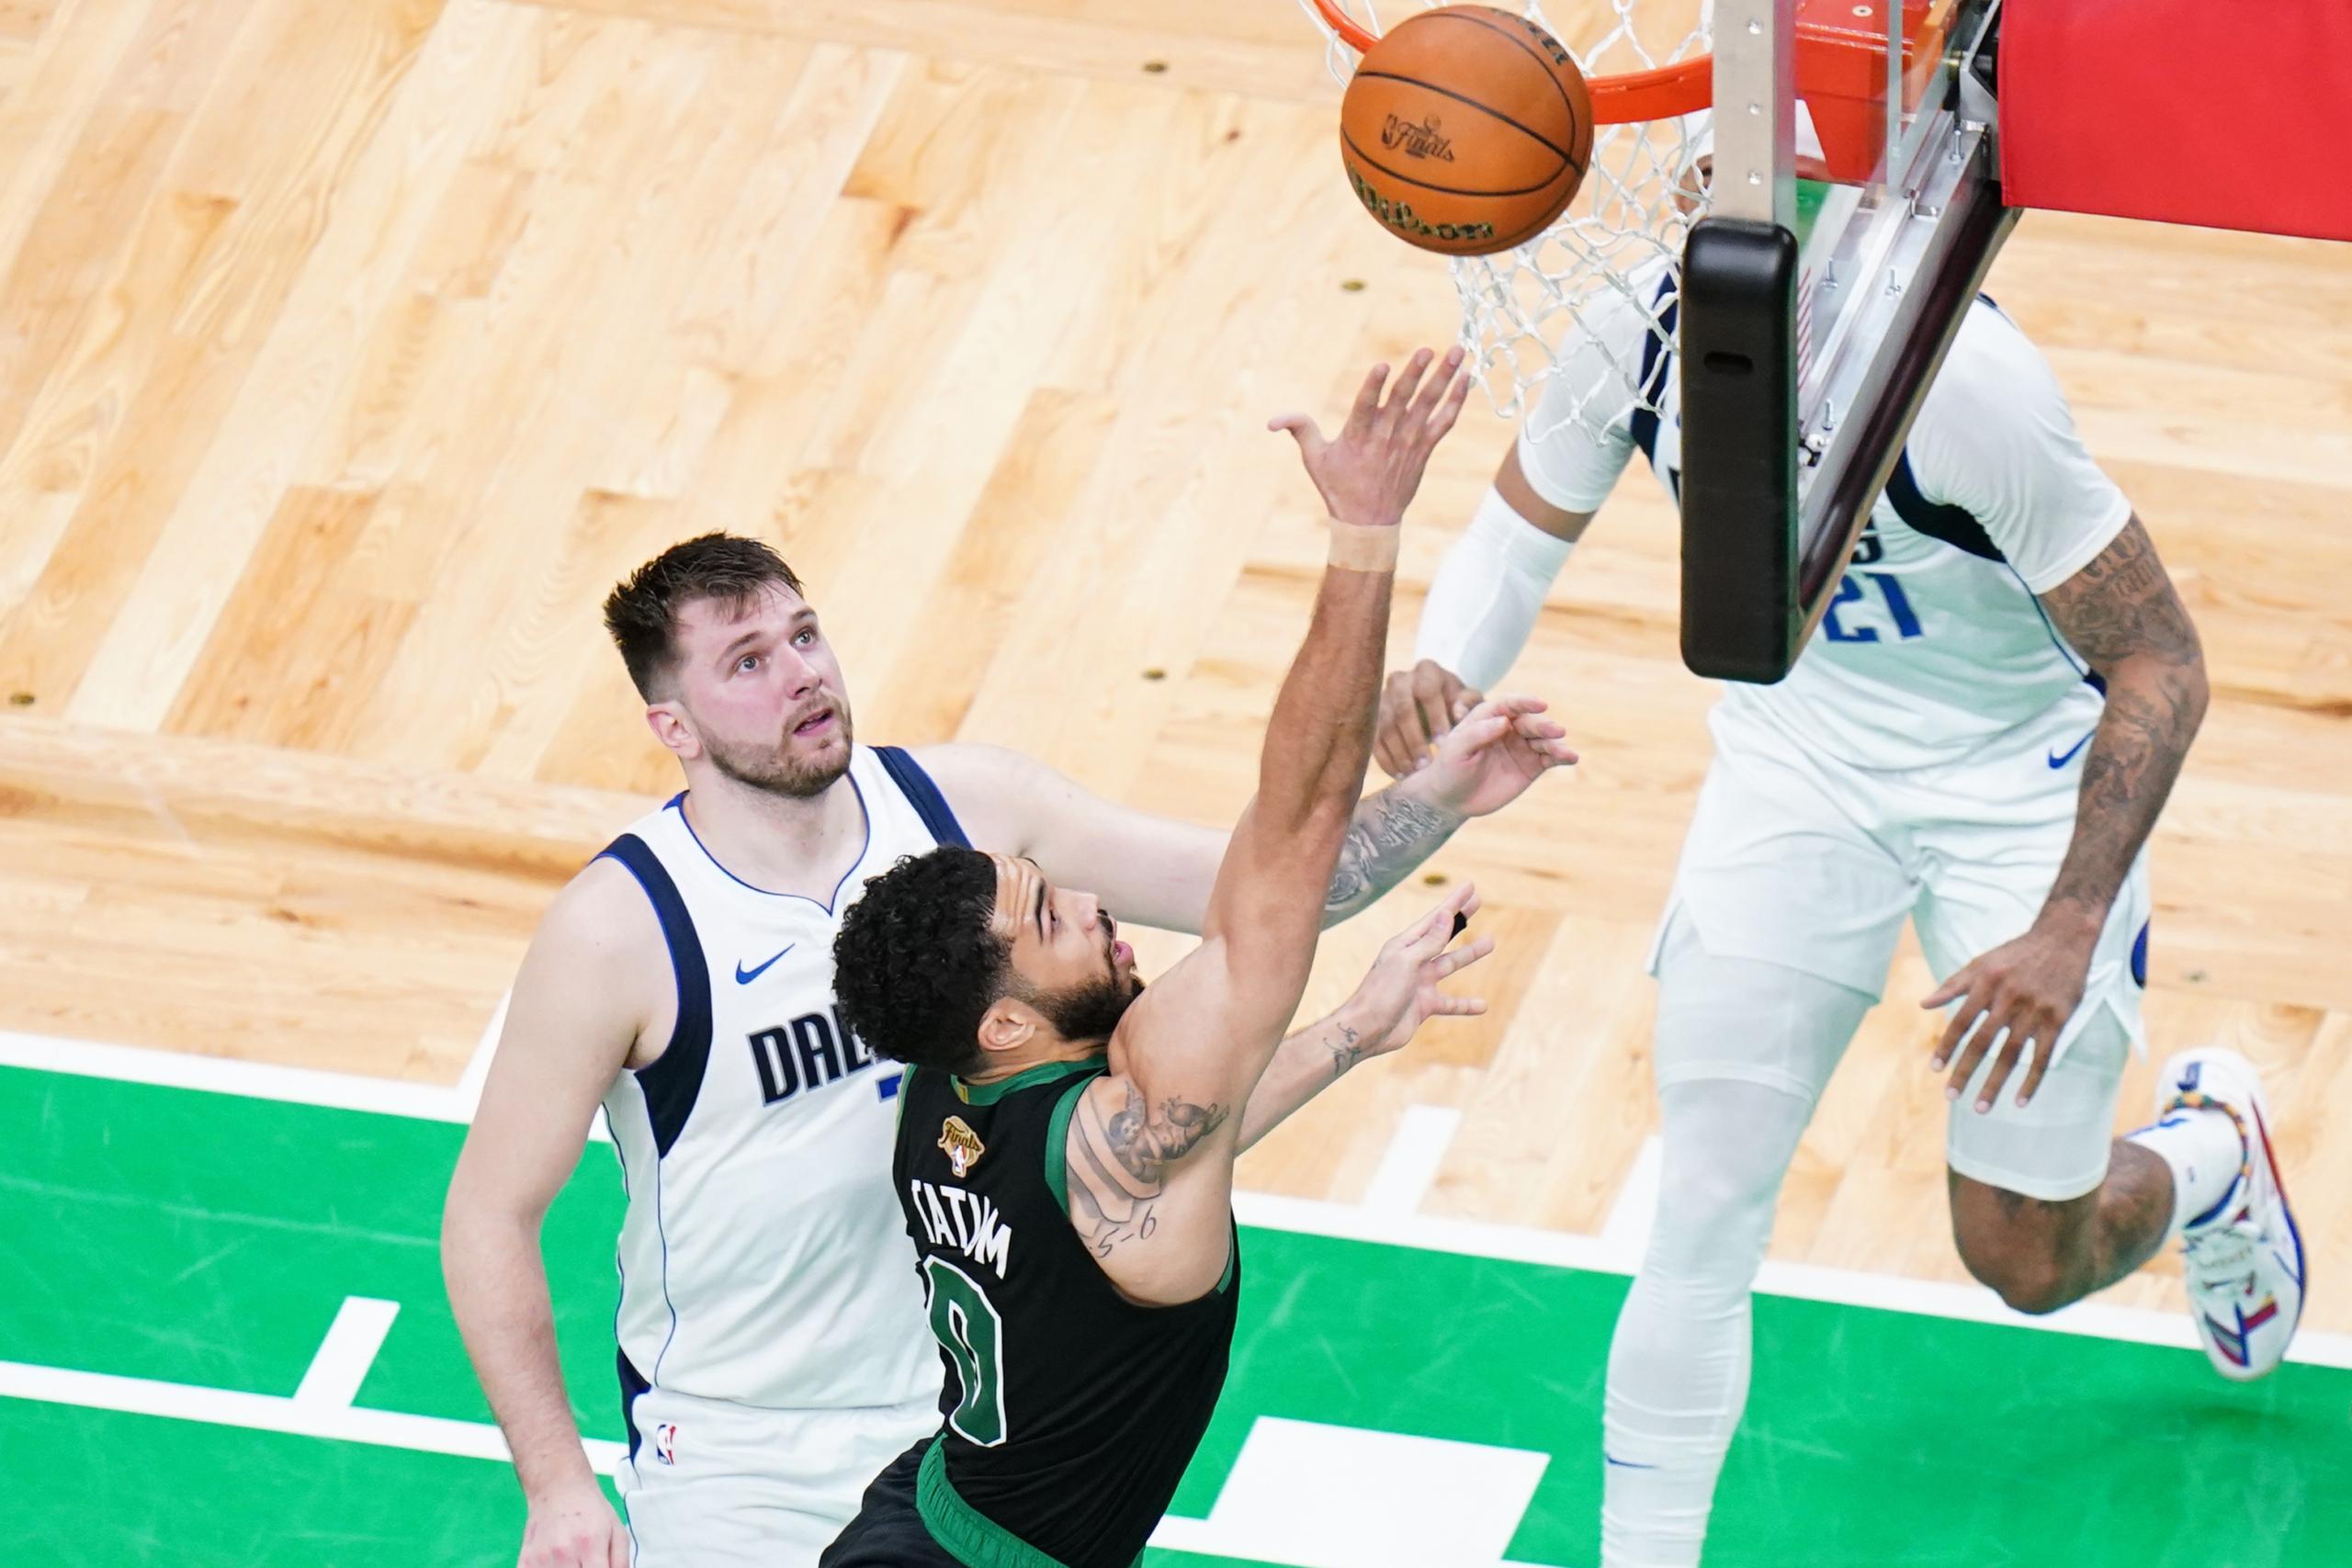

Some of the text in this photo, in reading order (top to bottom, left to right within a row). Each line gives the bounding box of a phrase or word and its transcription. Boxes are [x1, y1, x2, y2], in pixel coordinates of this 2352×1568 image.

[1385, 121, 1455, 163] Finals
[1823, 571, 1922, 643] 21
[745, 1003, 896, 1107] DAL
[939, 1121, 981, 1152] Finals
[911, 1179, 1012, 1280] TATUM
[922, 1254, 1007, 1448] 0
